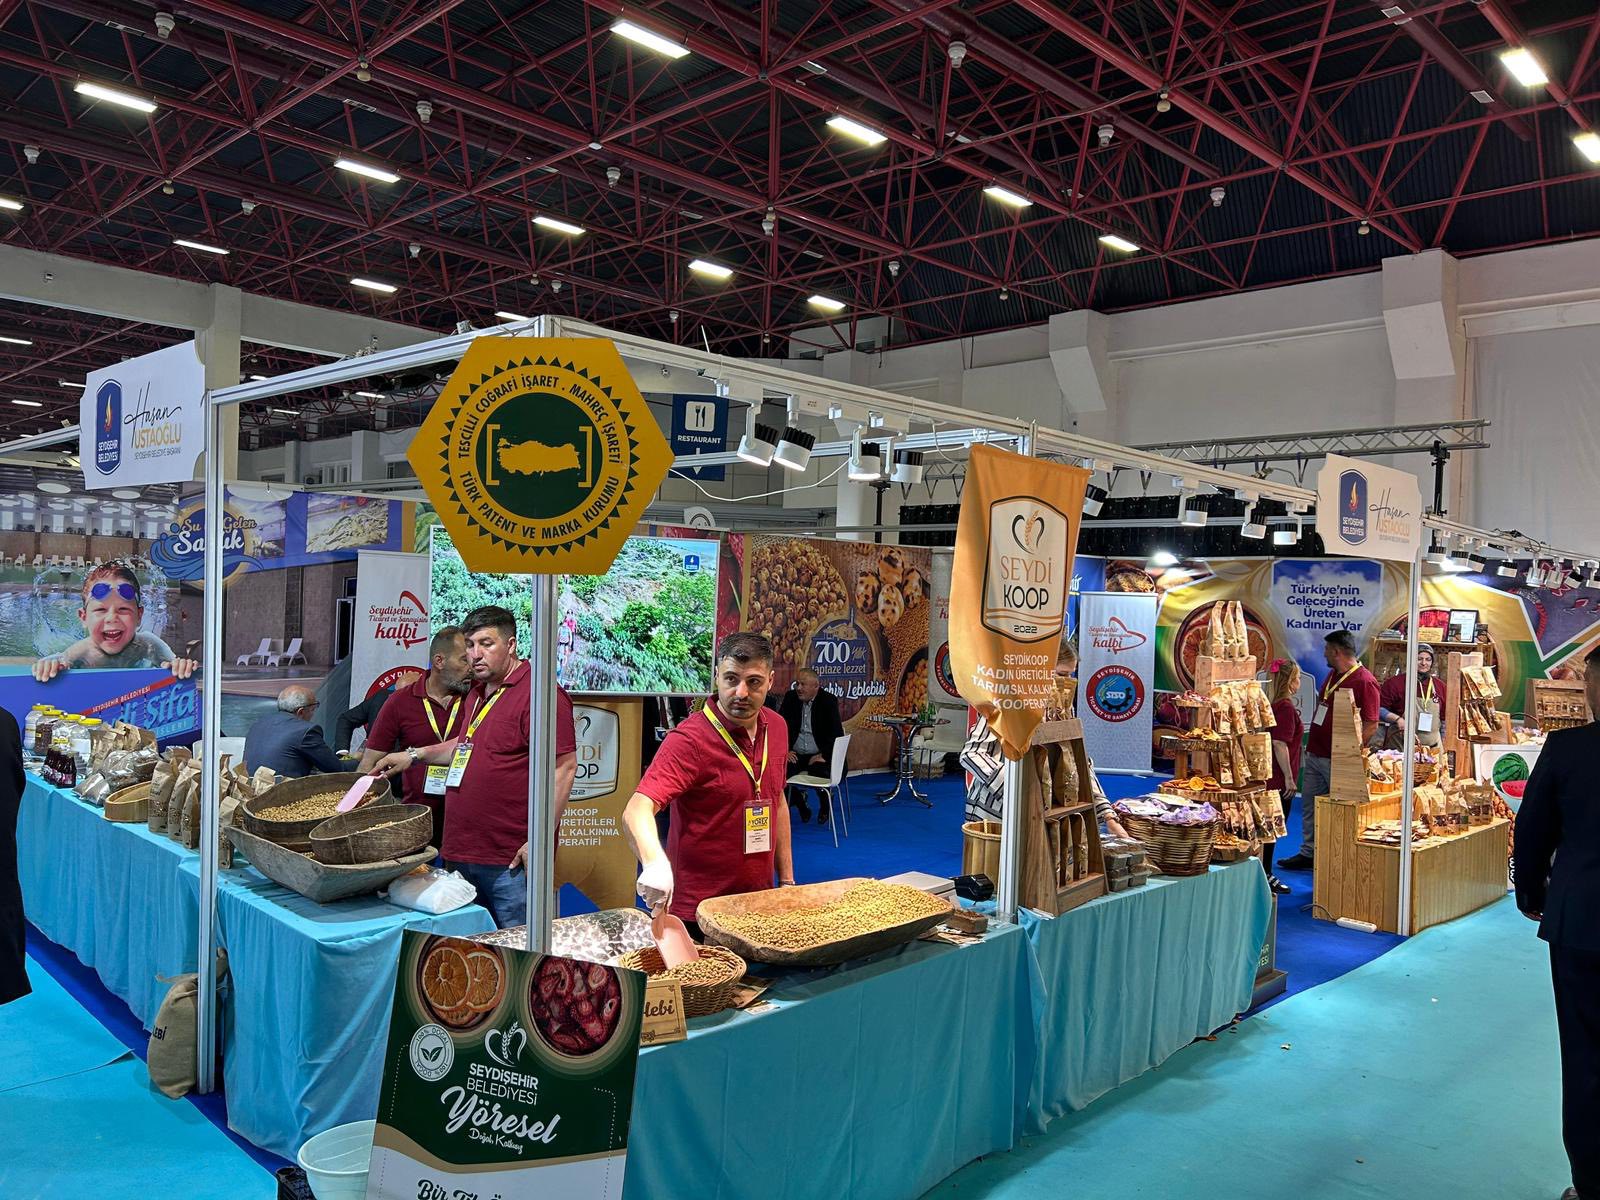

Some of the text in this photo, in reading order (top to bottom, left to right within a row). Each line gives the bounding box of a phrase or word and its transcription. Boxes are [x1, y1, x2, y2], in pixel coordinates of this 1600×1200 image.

[458, 373, 624, 464] TESCİLLİ COĞRAFİ İŞARET MAHREÇ İŞARETİ
[677, 435, 722, 444] RESTAURANT
[459, 471, 620, 540] TÜRK PATENT VE MARKA KURUMU
[1000, 555, 1053, 585] SEYDİ
[1003, 584, 1049, 610] KOOP
[1290, 584, 1360, 596] Türkiye'nin
[1287, 595, 1364, 608] Geleceğinde
[1304, 605, 1345, 618] Üreten
[375, 622, 418, 639] kalbi
[1013, 624, 1038, 634] 2022
[1286, 618, 1363, 631] Kadınlar Var
[1093, 637, 1123, 648] kalbi
[815, 641, 850, 663] 700
[1003, 652, 1049, 666] SEYDİKOOP
[843, 663, 866, 674] lezzet
[976, 664, 1014, 680] KADIN
[971, 674, 1028, 695] TARIMSAL
[570, 828, 620, 836] KALKINMA
[559, 837, 601, 846] PERATİFİ
[644, 1000, 675, 1017] lebi
[469, 1062, 539, 1090] SEYDİŞEHİR
[466, 1077, 538, 1106] BELEDİYESİ
[440, 1086, 561, 1144] Yöresel
